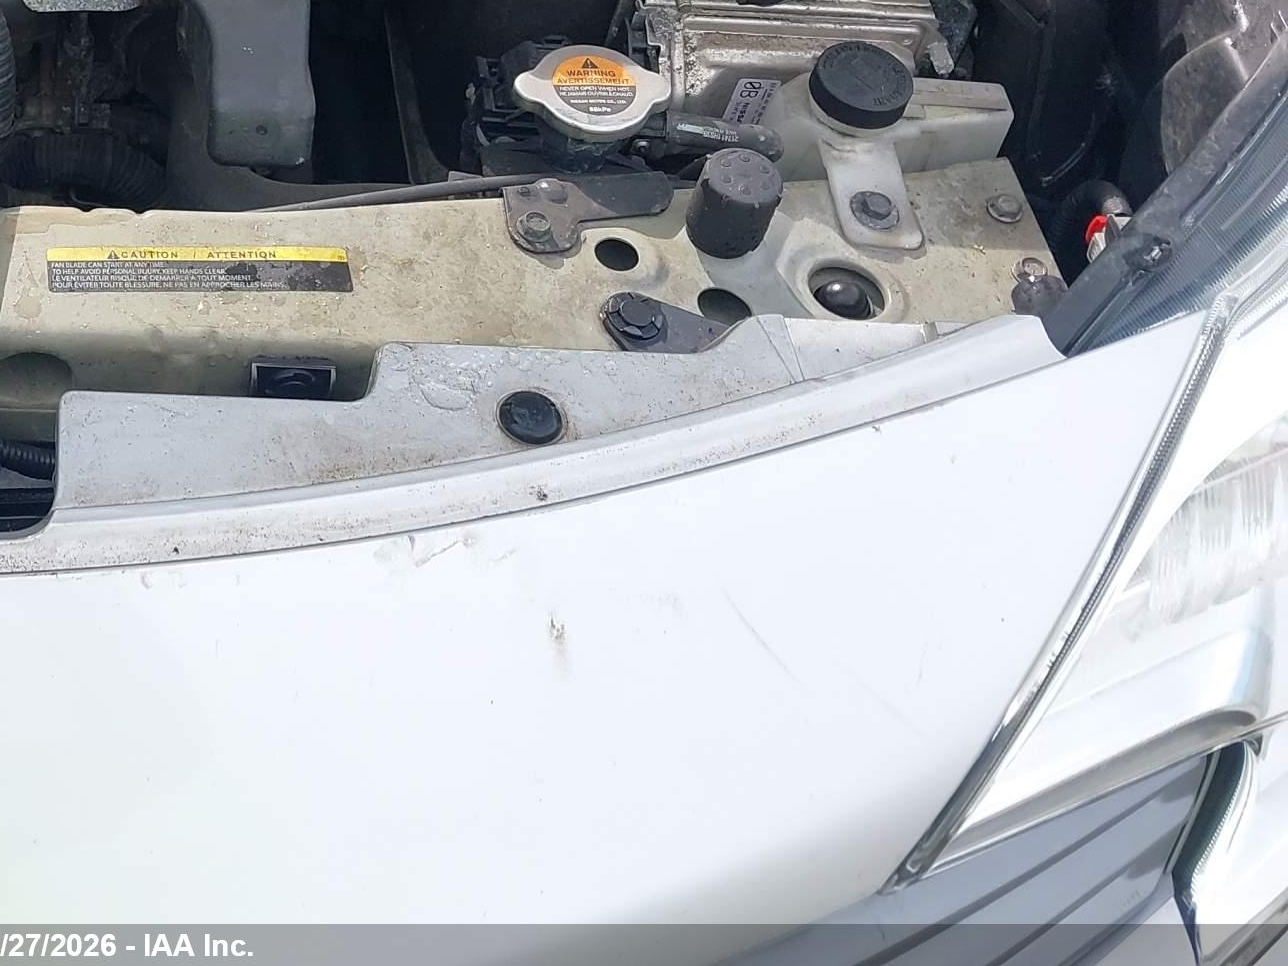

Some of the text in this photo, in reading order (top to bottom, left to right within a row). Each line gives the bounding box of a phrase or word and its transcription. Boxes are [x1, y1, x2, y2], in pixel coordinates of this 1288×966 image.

[567, 69, 616, 77] WARNING
[557, 77, 630, 85] AVERTISSEMENT
[121, 250, 178, 259] CAUTION
[207, 250, 277, 259] ATTENTION
